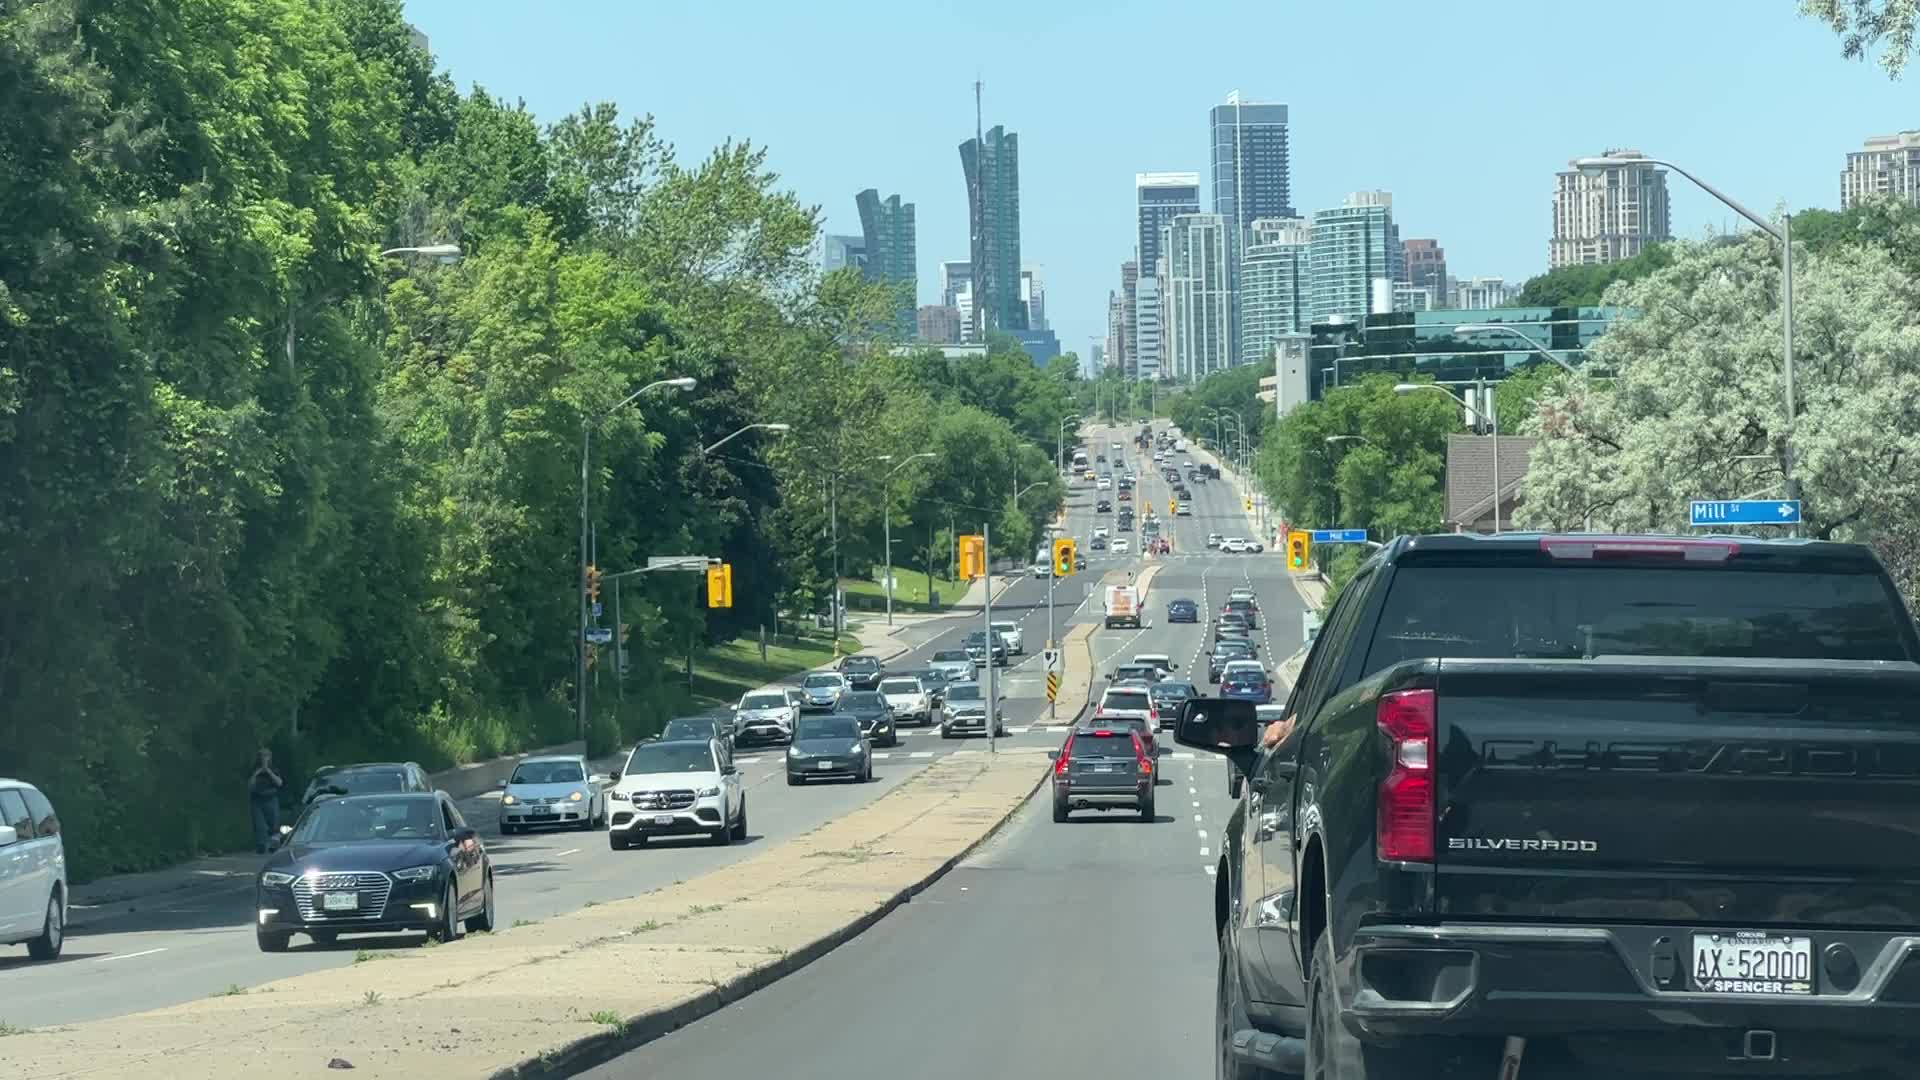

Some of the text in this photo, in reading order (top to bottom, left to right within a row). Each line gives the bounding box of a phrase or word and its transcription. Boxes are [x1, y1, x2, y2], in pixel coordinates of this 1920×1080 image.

[1695, 503, 1726, 519] Mill
[1448, 837, 1598, 852] SILVERADO
[1714, 979, 1784, 993] SPENCER
